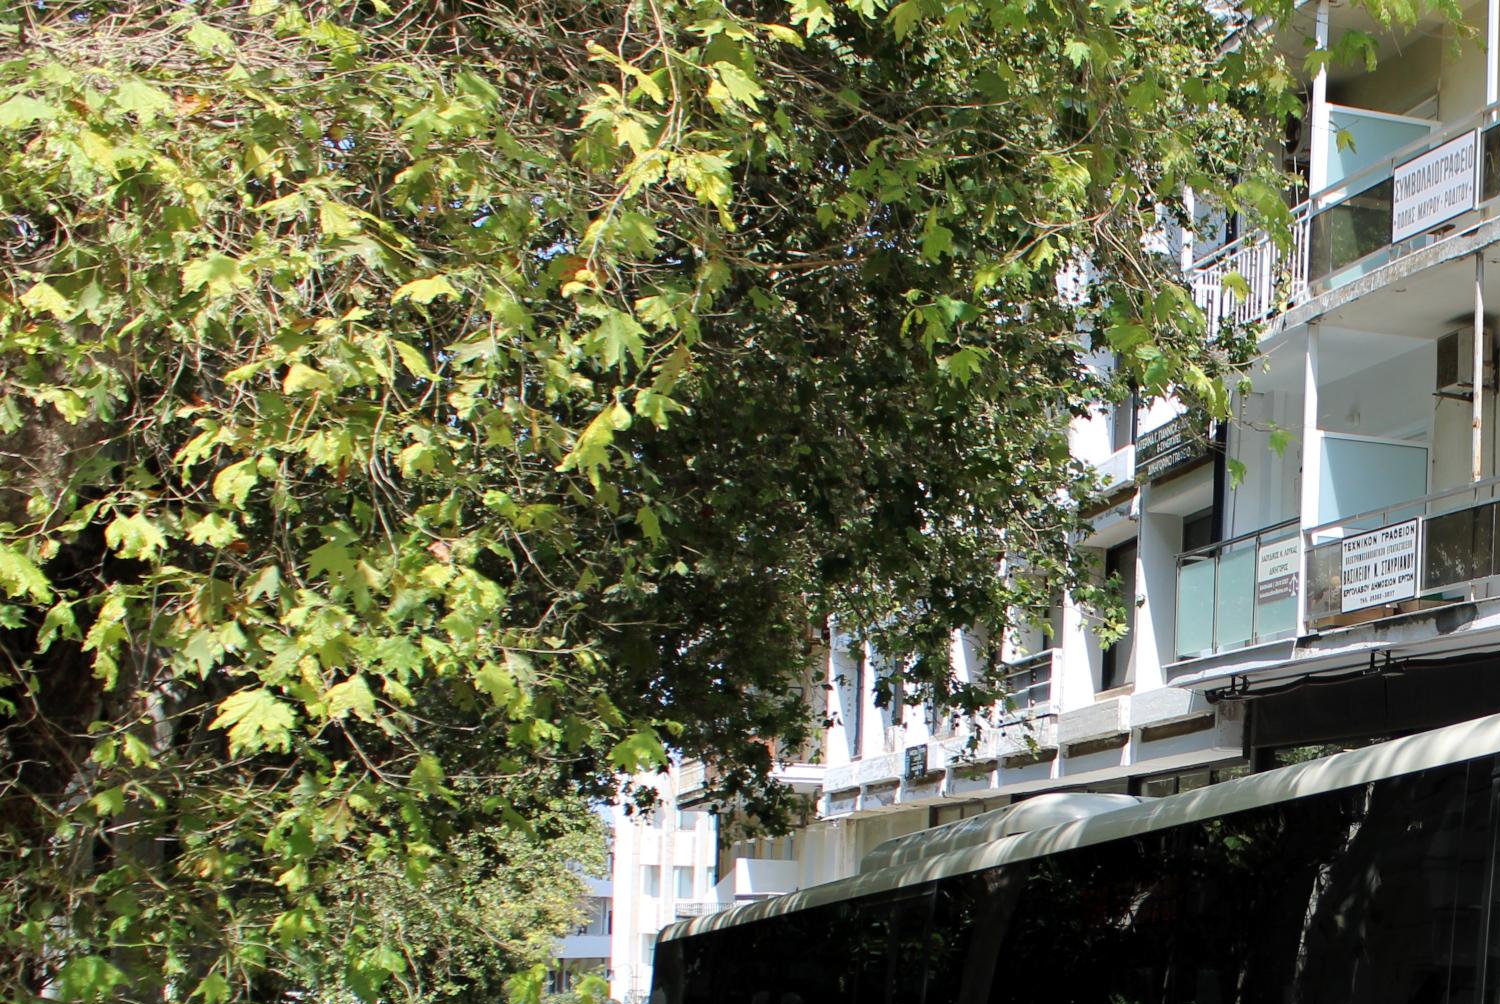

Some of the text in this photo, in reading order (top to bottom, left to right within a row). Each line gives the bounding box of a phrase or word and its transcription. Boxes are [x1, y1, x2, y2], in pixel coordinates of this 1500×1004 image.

[1395, 144, 1473, 203] ΣΥΜΒΟΛΑΙΟΓΡΑΦΕΙΟ
[1344, 525, 1415, 552] ΤΕΧΝΙΚΟΝ ΓΡΑΦΕΙΟΝ
[1343, 564, 1370, 586] ΒΑΣΙΛΕΙΟΥ
[1381, 553, 1414, 576] ΣΤΑΥΡΙΑΝΟΥ
[1343, 585, 1369, 597] ΕΡΓΟΛΑΒΟΥ
